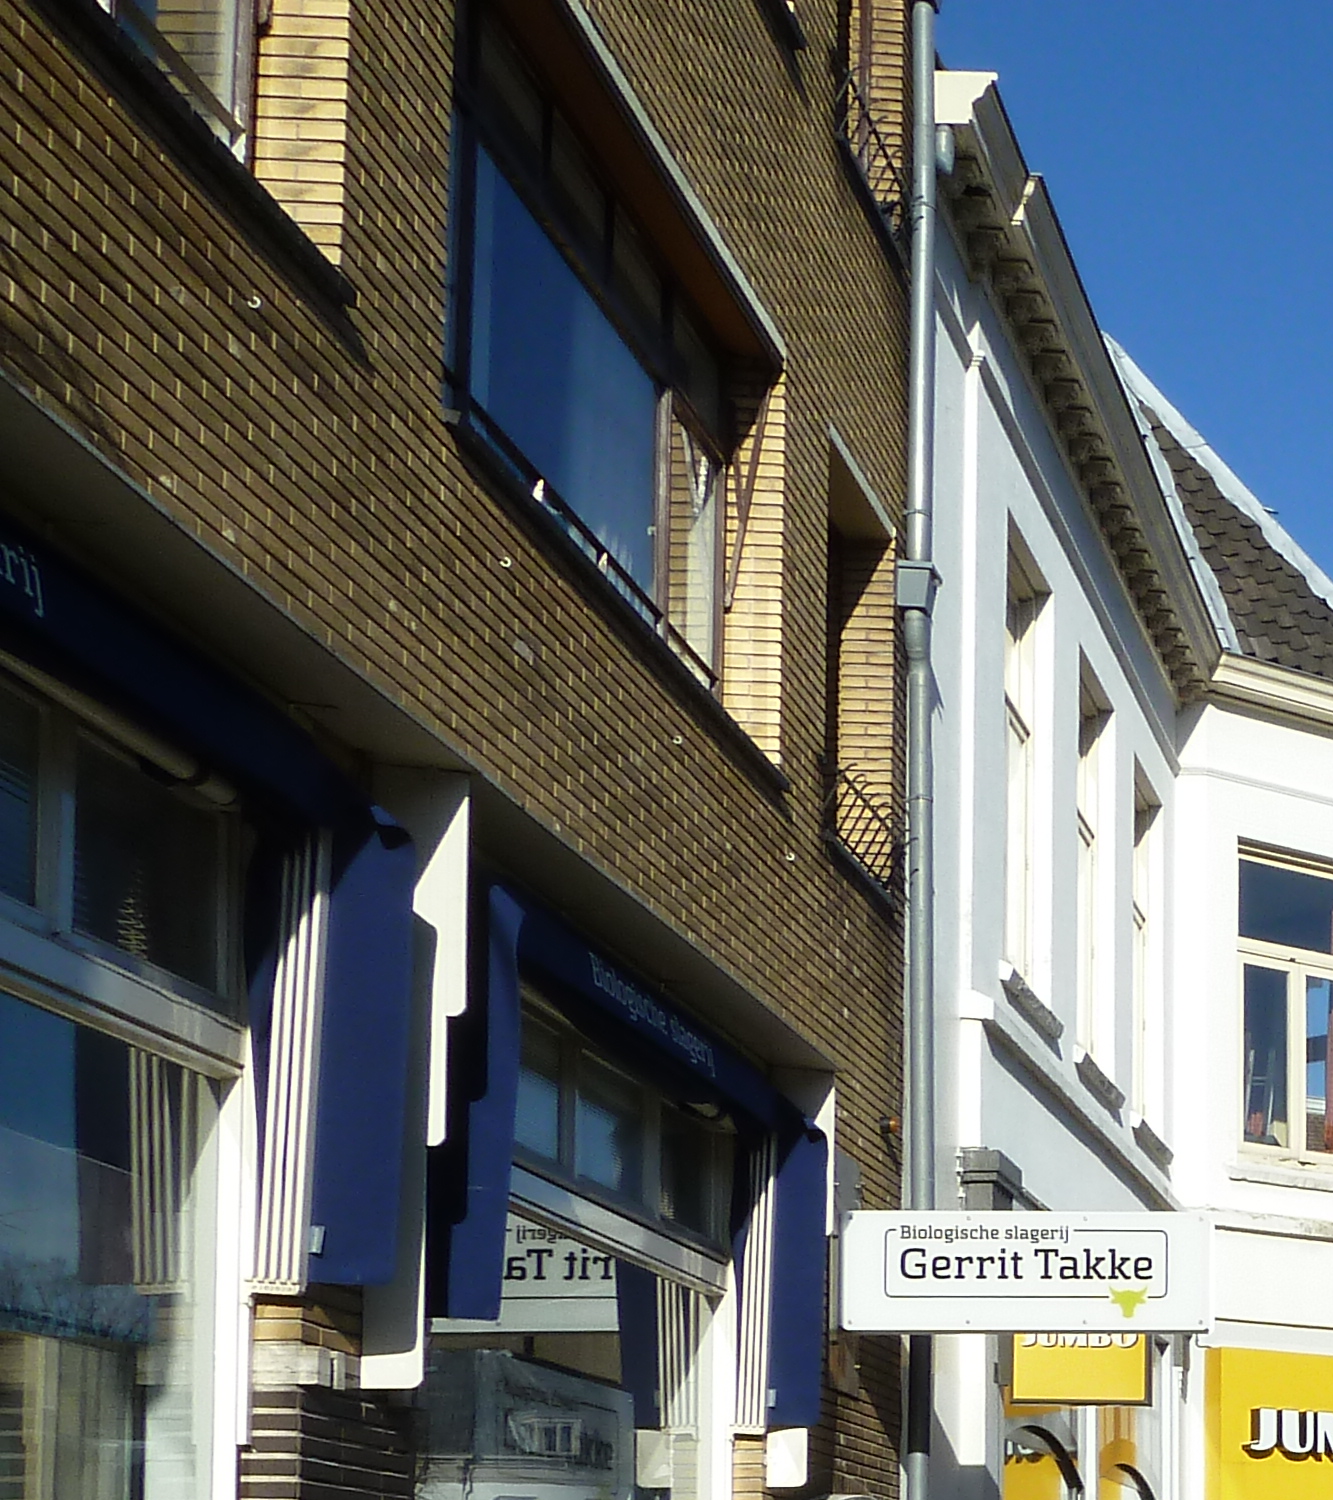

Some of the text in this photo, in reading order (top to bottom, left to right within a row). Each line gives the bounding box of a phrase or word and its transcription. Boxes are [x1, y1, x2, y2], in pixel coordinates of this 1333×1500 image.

[0, 542, 45, 618] rij
[900, 1225, 1070, 1243] Biologische slagerij
[900, 1248, 1153, 1280] Gerrit Takke
